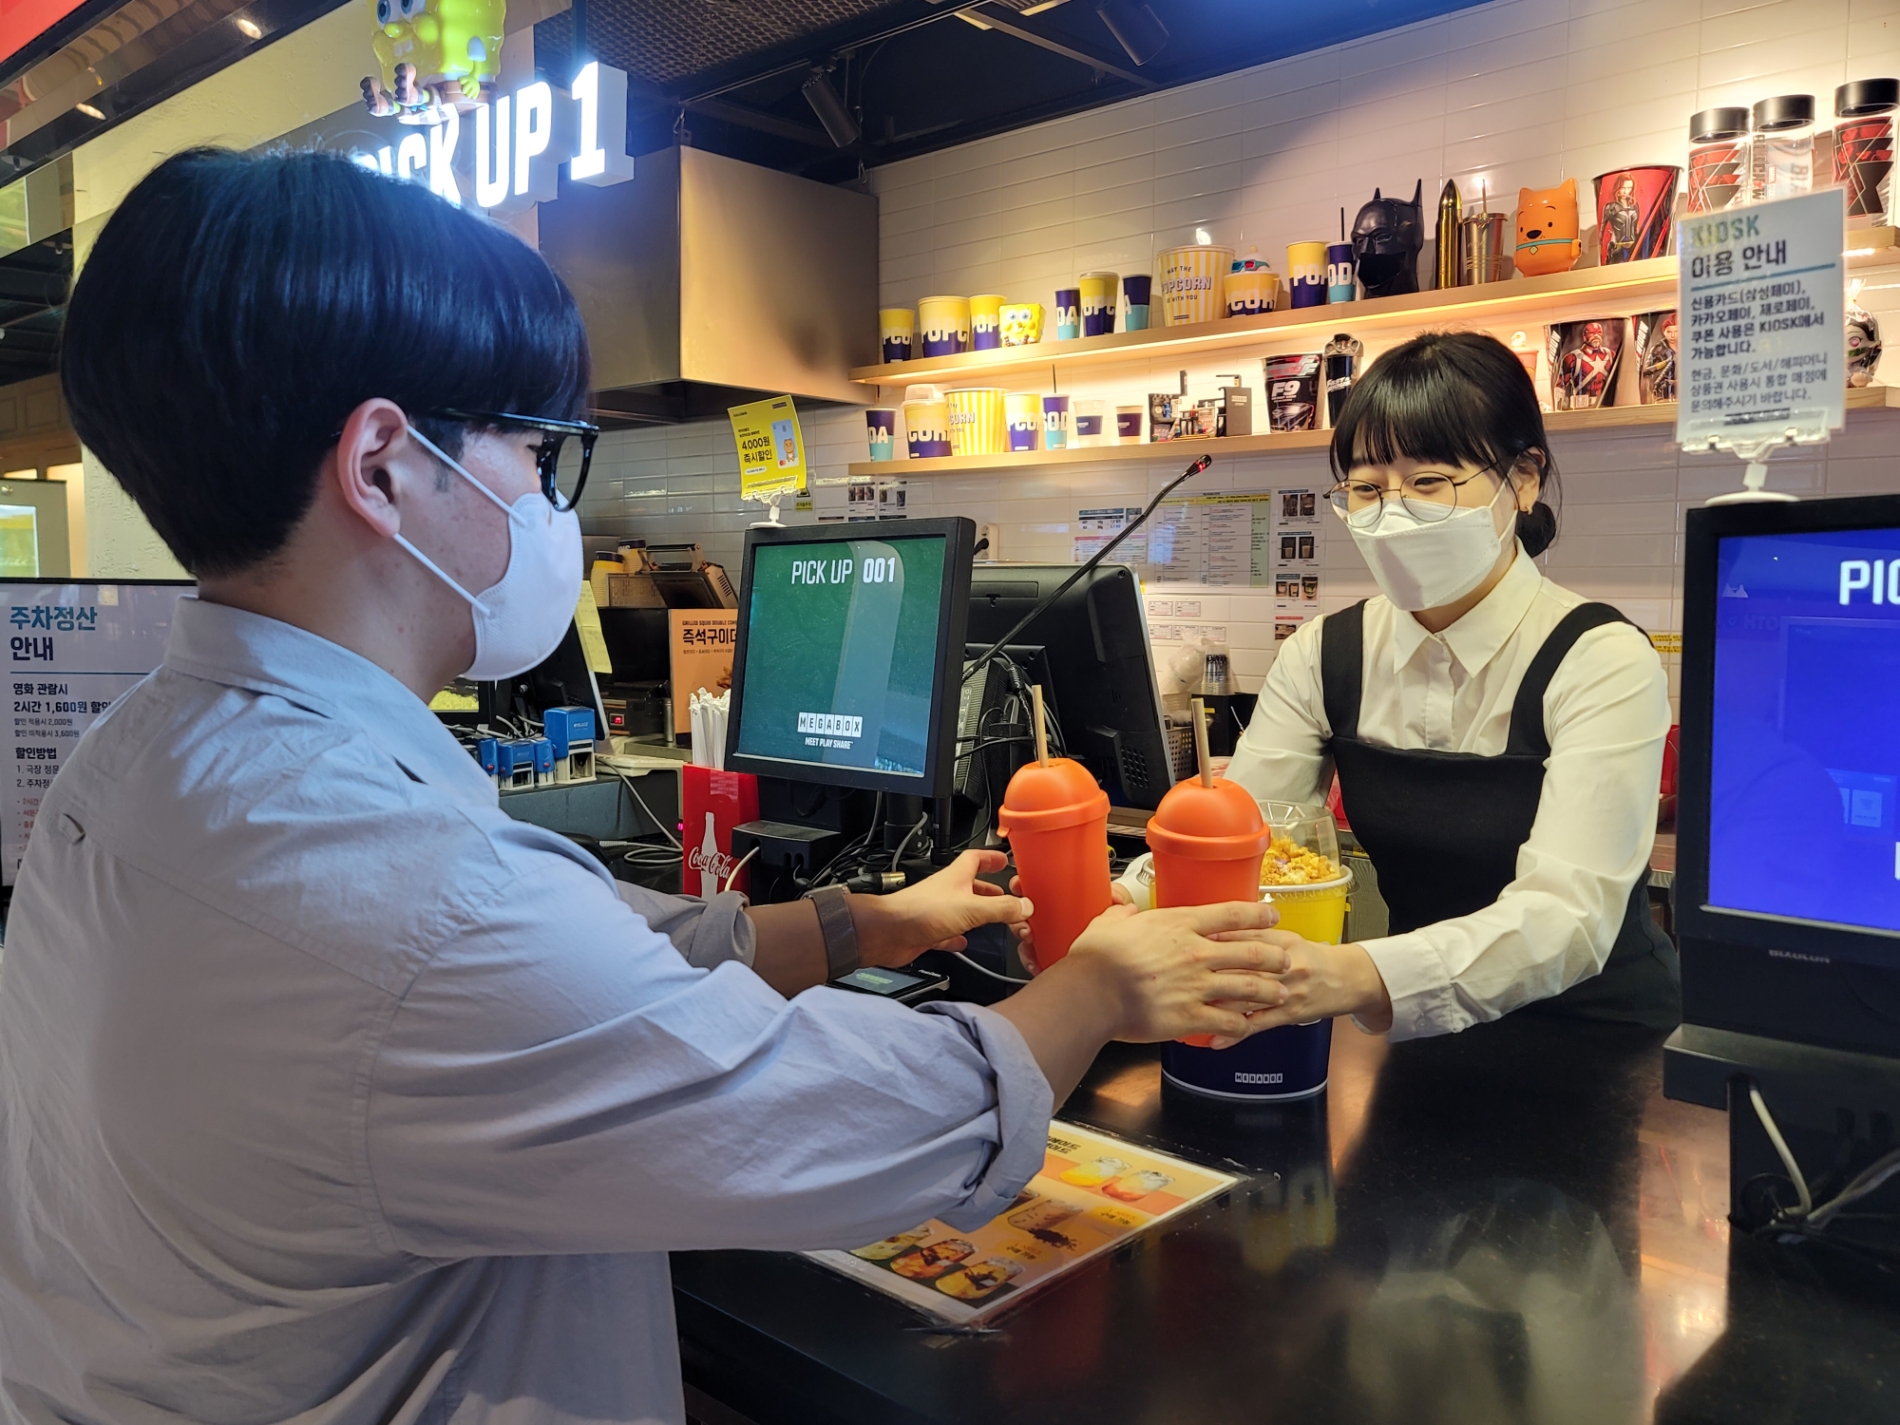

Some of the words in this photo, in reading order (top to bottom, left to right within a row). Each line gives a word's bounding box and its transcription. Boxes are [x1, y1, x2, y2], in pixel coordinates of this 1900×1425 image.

[476, 81, 551, 207] UP
[571, 61, 605, 181] 1
[1691, 214, 1760, 247] KIOSK
[1691, 249, 1734, 279] 이용
[1743, 239, 1787, 271] 안내
[1180, 265, 1192, 273] THE
[1691, 328, 1715, 344] 쿠폰
[1718, 322, 1755, 340] 사용은
[1759, 312, 1825, 334] KIOSK에서
[1691, 340, 1757, 361] 가능합니다.
[1271, 380, 1301, 398] F9
[1691, 381, 1724, 398] 상품권
[1726, 375, 1760, 392] 사용시
[1691, 392, 1758, 414] 문의해주시기
[1760, 386, 1812, 405] 바랍니다.
[743, 449, 773, 464] 즉시할인
[791, 559, 827, 584] PICK
[830, 558, 853, 583] UP
[862, 557, 896, 583] 001
[10, 606, 98, 632] 주차정산
[10, 636, 54, 661] 안내
[13, 683, 34, 696] 영화
[37, 683, 68, 696] 관람시
[14, 701, 41, 713] 2시간
[45, 701, 87, 714] 1,600원
[14, 718, 27, 726] 할인
[28, 718, 47, 726] 적용시
[48, 718, 73, 727] 2,000원
[798, 714, 862, 736] MEGABOX
[14, 730, 27, 738] 할인
[29, 730, 53, 738] 미적용시
[54, 729, 80, 738] 3,600원
[805, 736, 819, 747] MEET
[819, 738, 833, 748] PLAY
[16, 747, 57, 760] 할인방법
[17, 765, 24, 774] 1.
[26, 765, 42, 775] 극장
[17, 778, 25, 788] 2.
[1235, 1072, 1283, 1084] MEGABOX
